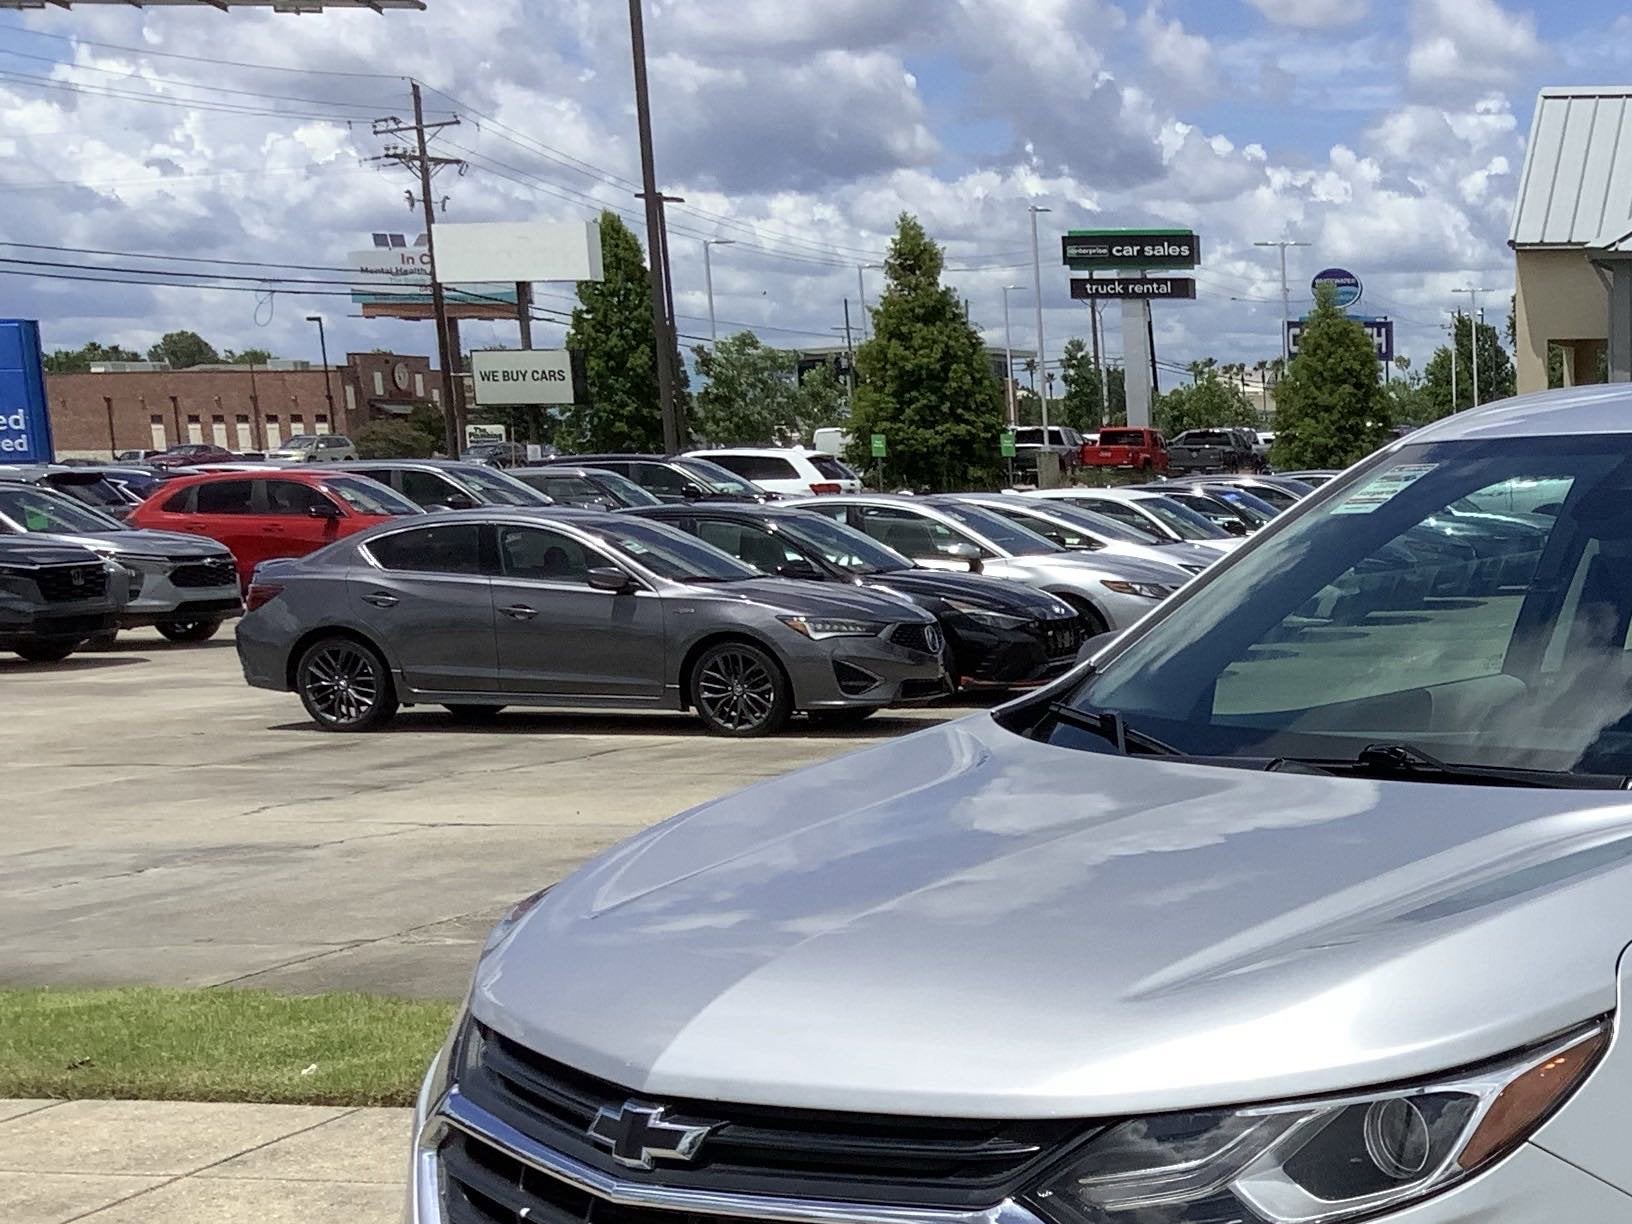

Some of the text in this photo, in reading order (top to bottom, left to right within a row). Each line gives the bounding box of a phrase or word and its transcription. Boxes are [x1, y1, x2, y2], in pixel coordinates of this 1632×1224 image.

[1111, 245, 1141, 257] car
[1143, 241, 1190, 257] sales
[401, 253, 415, 265] In
[396, 266, 426, 275] Health
[1085, 280, 1172, 294] truck rental
[479, 369, 566, 382] WE BUY CARS
